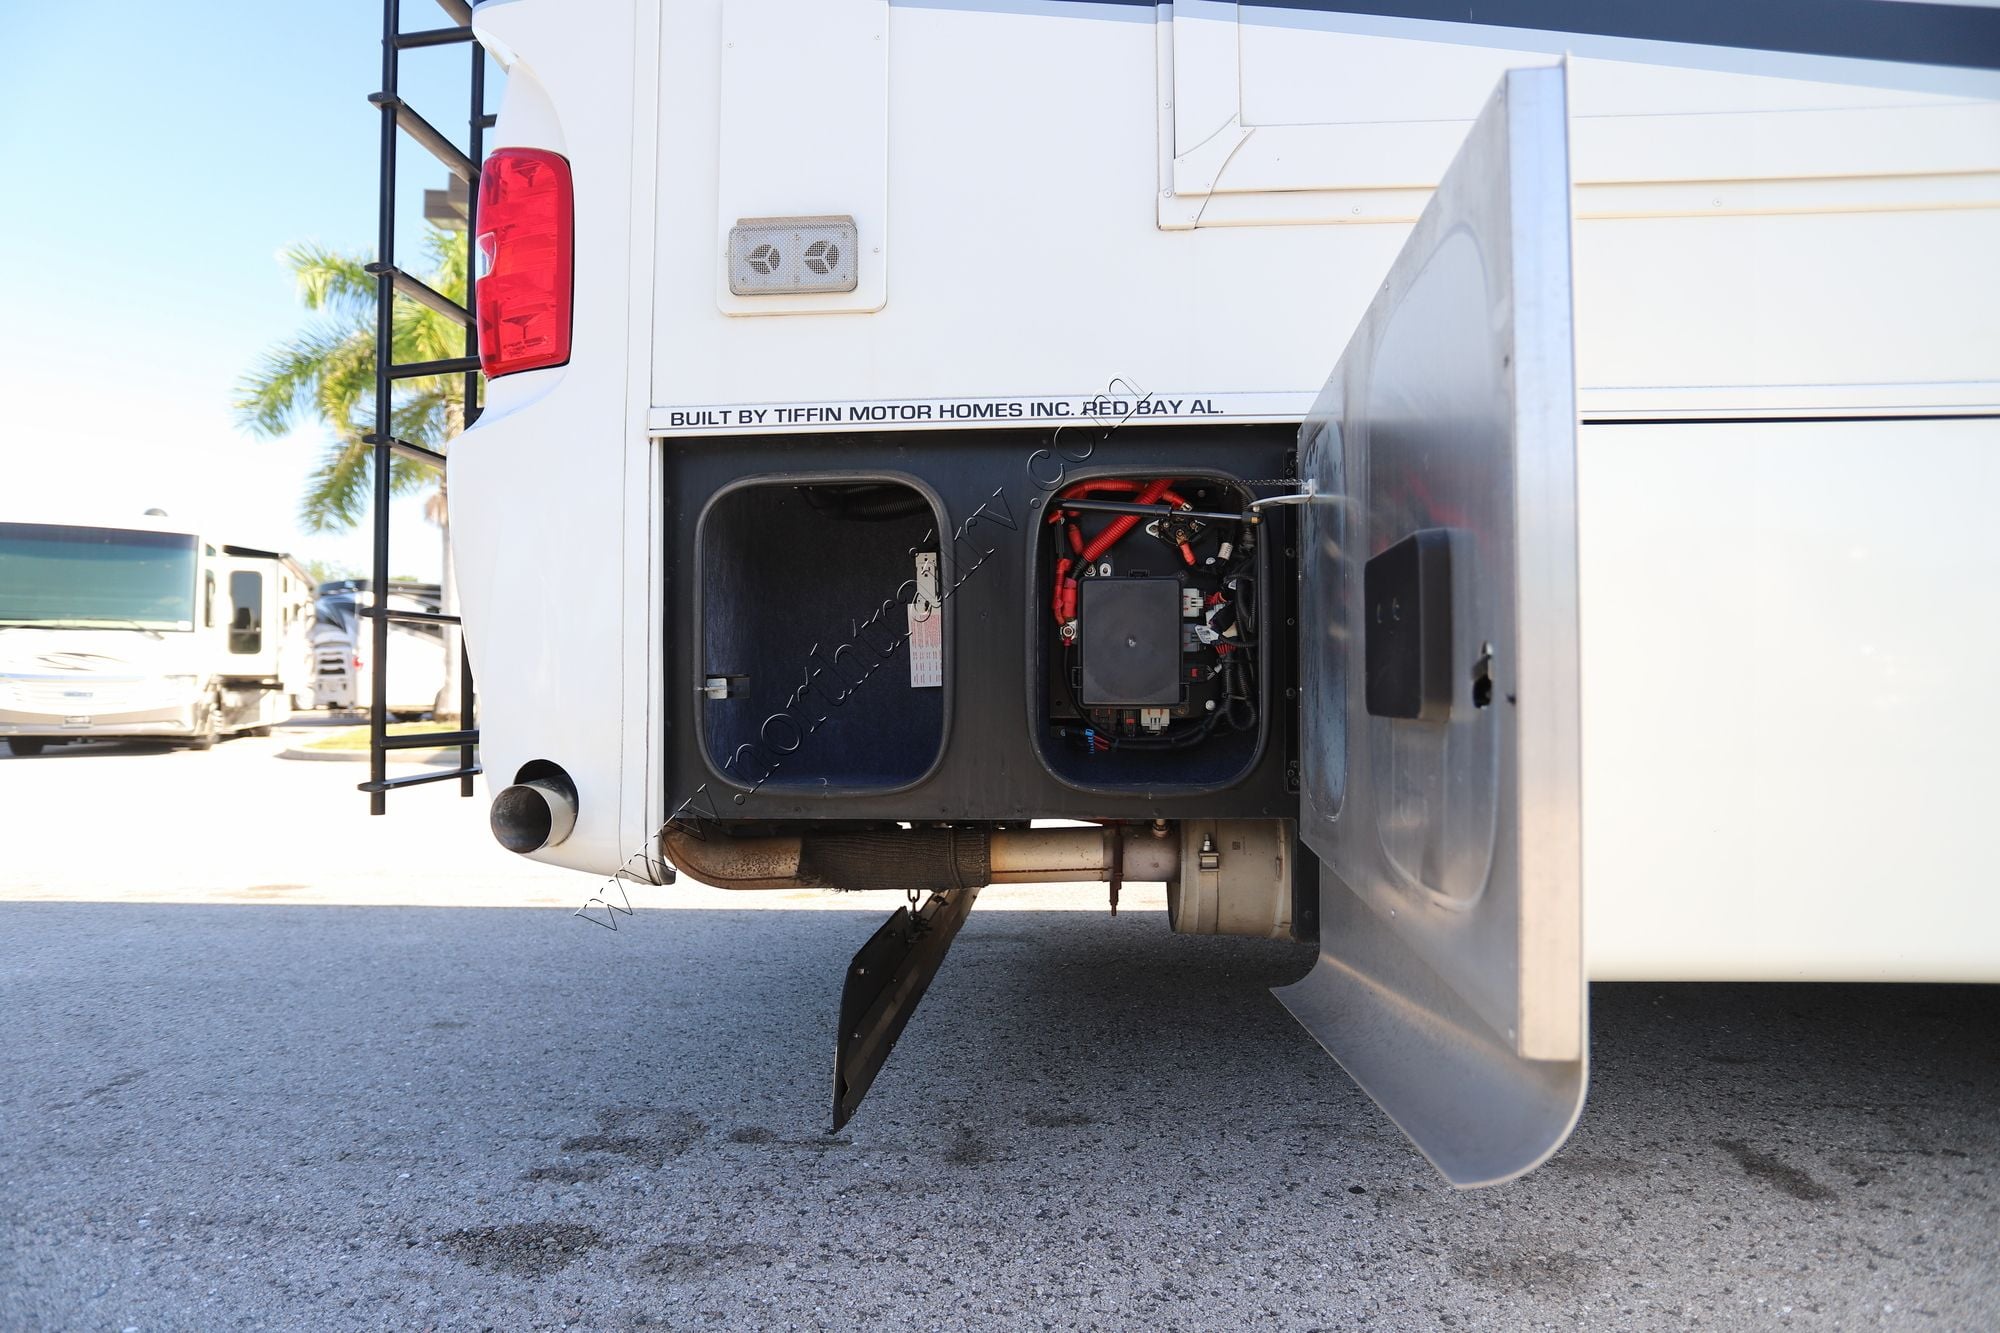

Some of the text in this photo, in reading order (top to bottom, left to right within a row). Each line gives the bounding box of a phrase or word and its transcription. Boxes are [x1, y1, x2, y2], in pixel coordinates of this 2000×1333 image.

[670, 399, 1224, 427] BUILT BY TIFFIN MOTOR HOMES INC. RED BAY AL.
